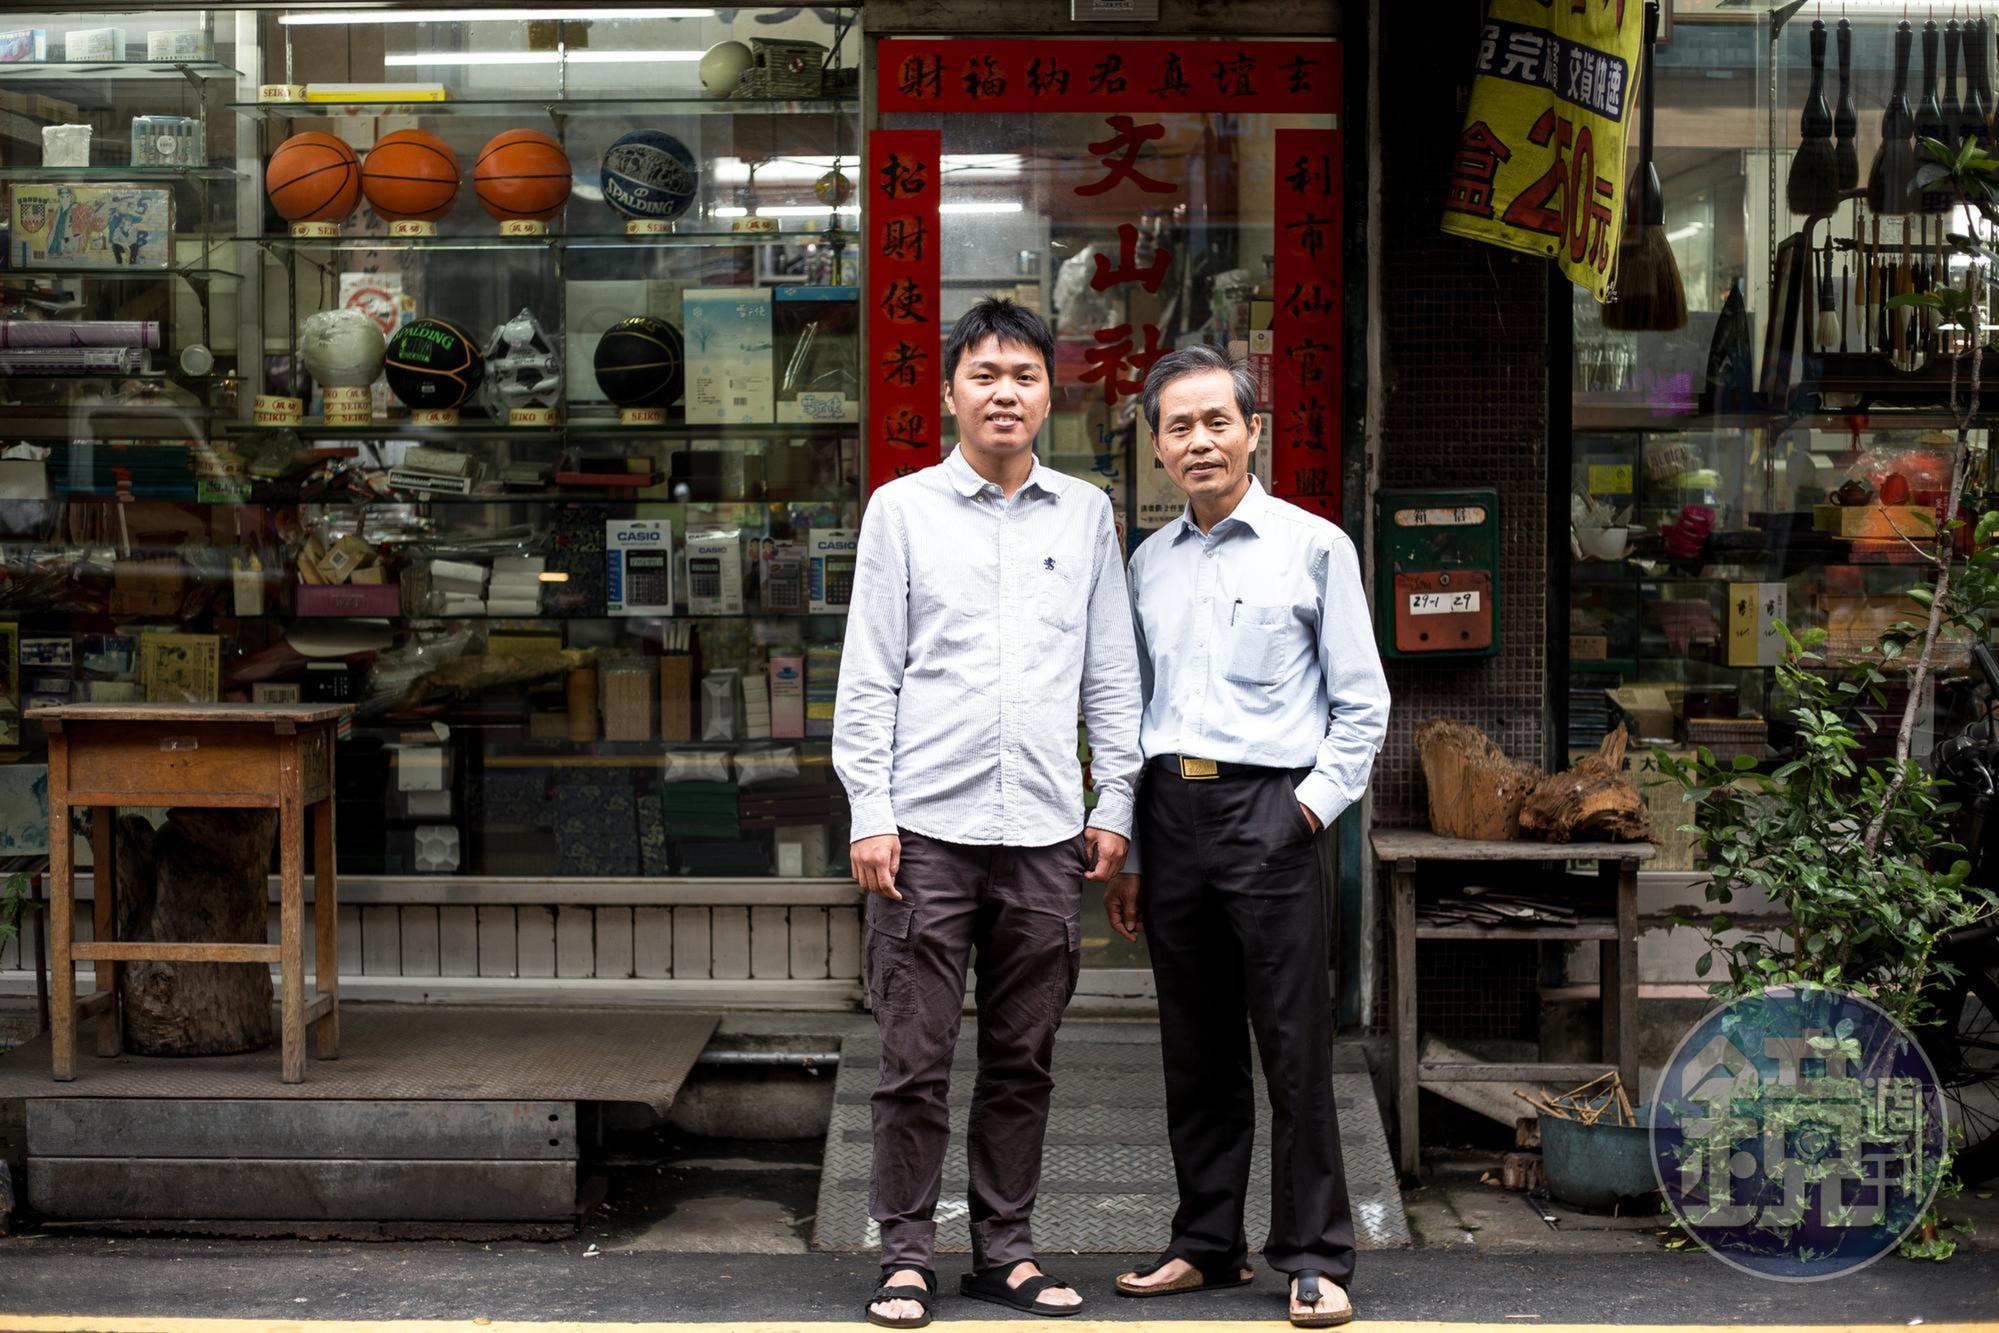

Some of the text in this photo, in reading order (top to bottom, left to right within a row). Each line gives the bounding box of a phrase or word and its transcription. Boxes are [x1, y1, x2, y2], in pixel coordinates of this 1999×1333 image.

[605, 177, 675, 214] SPALDING
[617, 531, 660, 541] CASIO
[1413, 593, 1472, 610] 29-1 29
